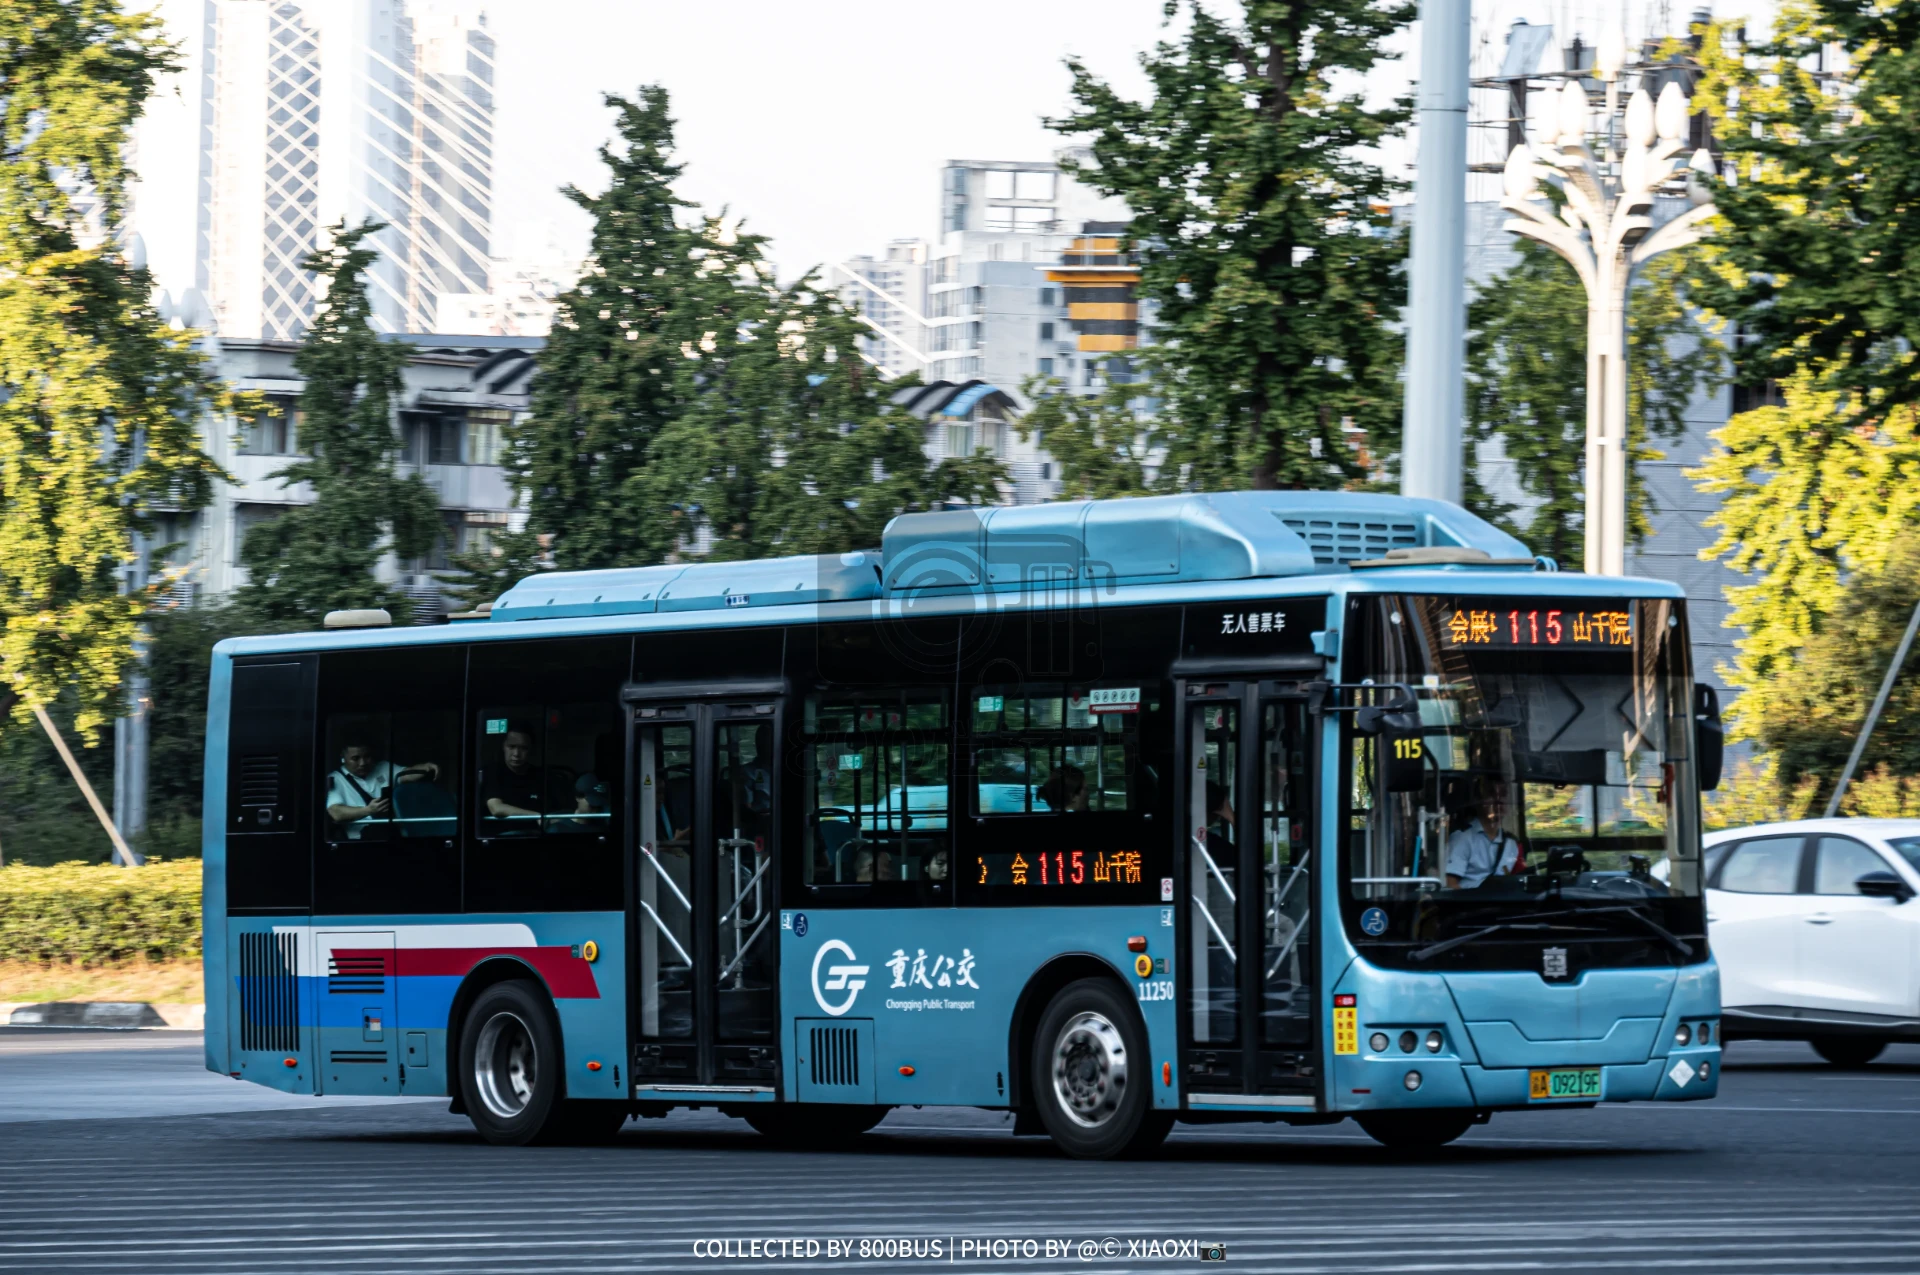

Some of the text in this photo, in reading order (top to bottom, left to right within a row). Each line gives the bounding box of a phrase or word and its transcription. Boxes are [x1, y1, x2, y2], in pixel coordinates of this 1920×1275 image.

[1221, 612, 1286, 634] 无人售票车
[1507, 609, 1563, 645] 115
[1572, 610, 1633, 645] 山千院
[1393, 738, 1422, 759] 115
[1038, 850, 1085, 885] 115
[885, 948, 980, 990] 重庆公交
[1138, 981, 1174, 1001] 11250
[885, 998, 975, 1012] Chongqing Public Transport
